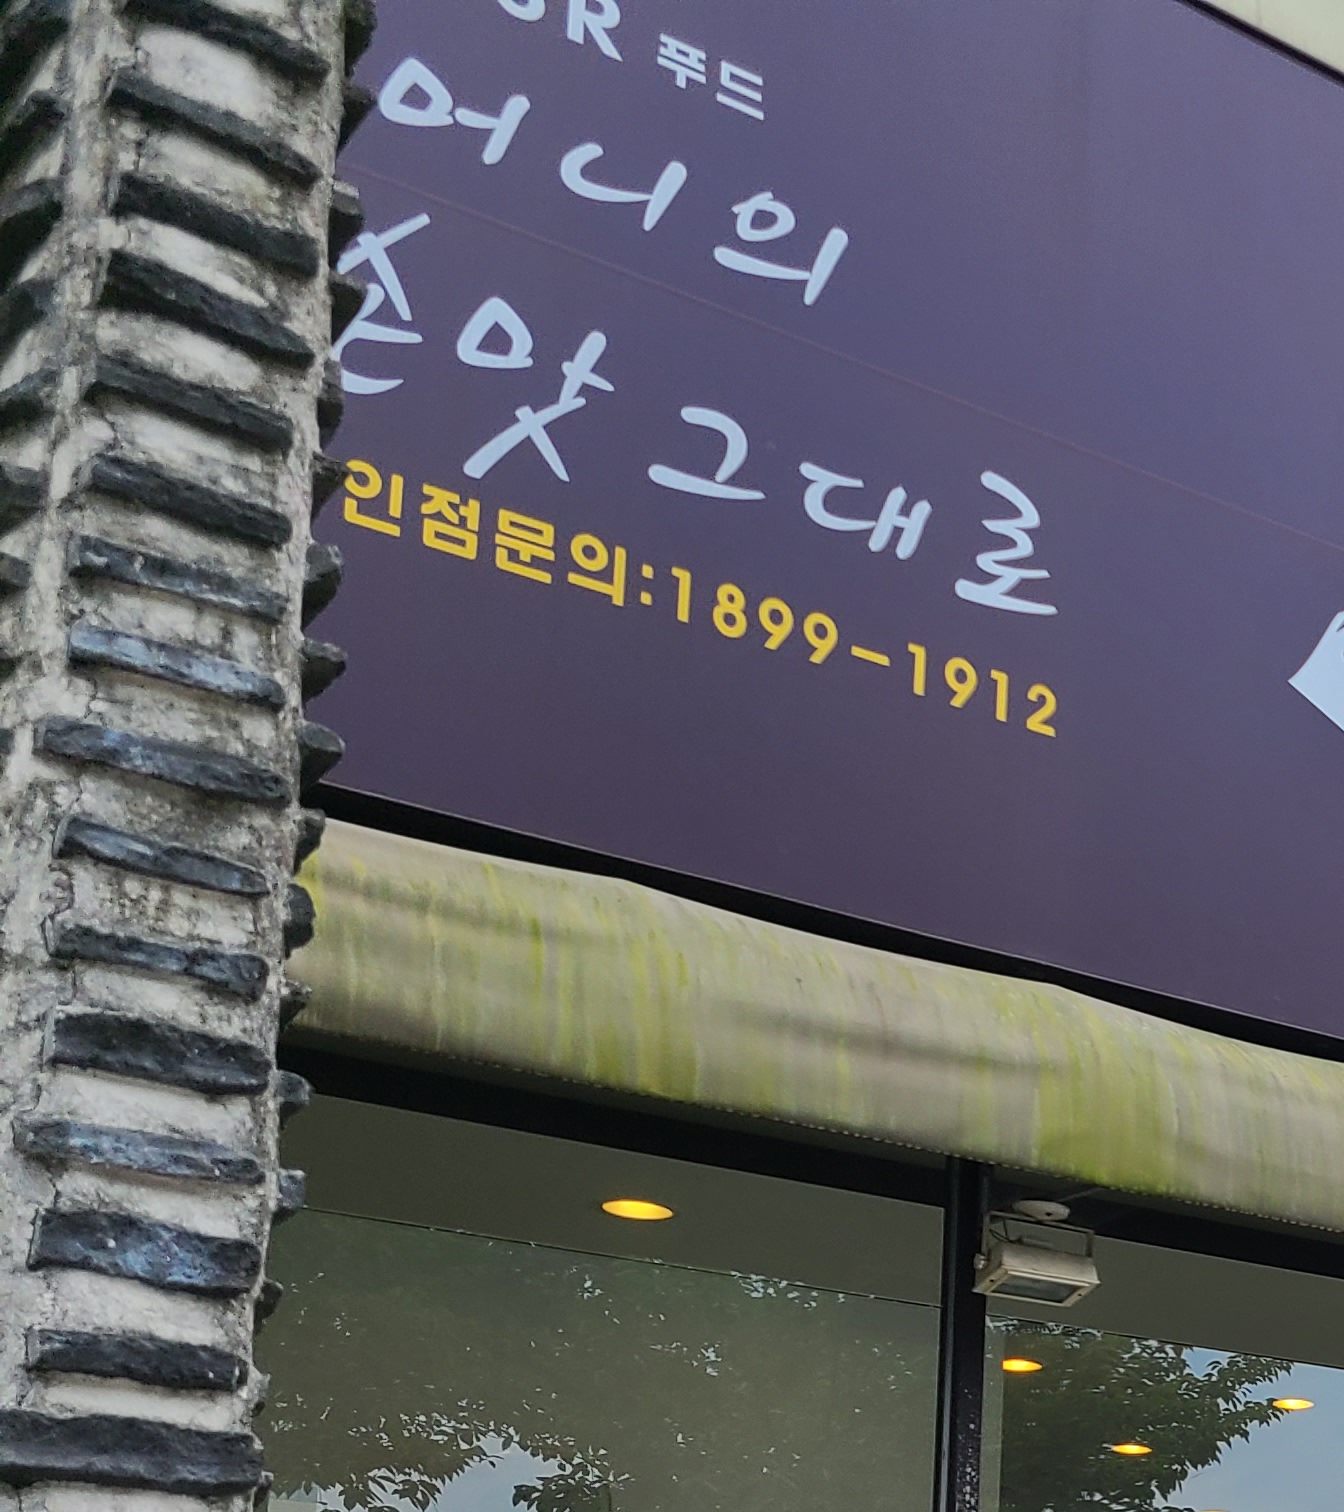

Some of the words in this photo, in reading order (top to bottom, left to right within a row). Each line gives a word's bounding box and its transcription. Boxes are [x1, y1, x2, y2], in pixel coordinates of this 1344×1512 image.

[657, 33, 764, 120] 푸드
[332, 213, 616, 482] 손맛
[649, 406, 1058, 615] 그대로
